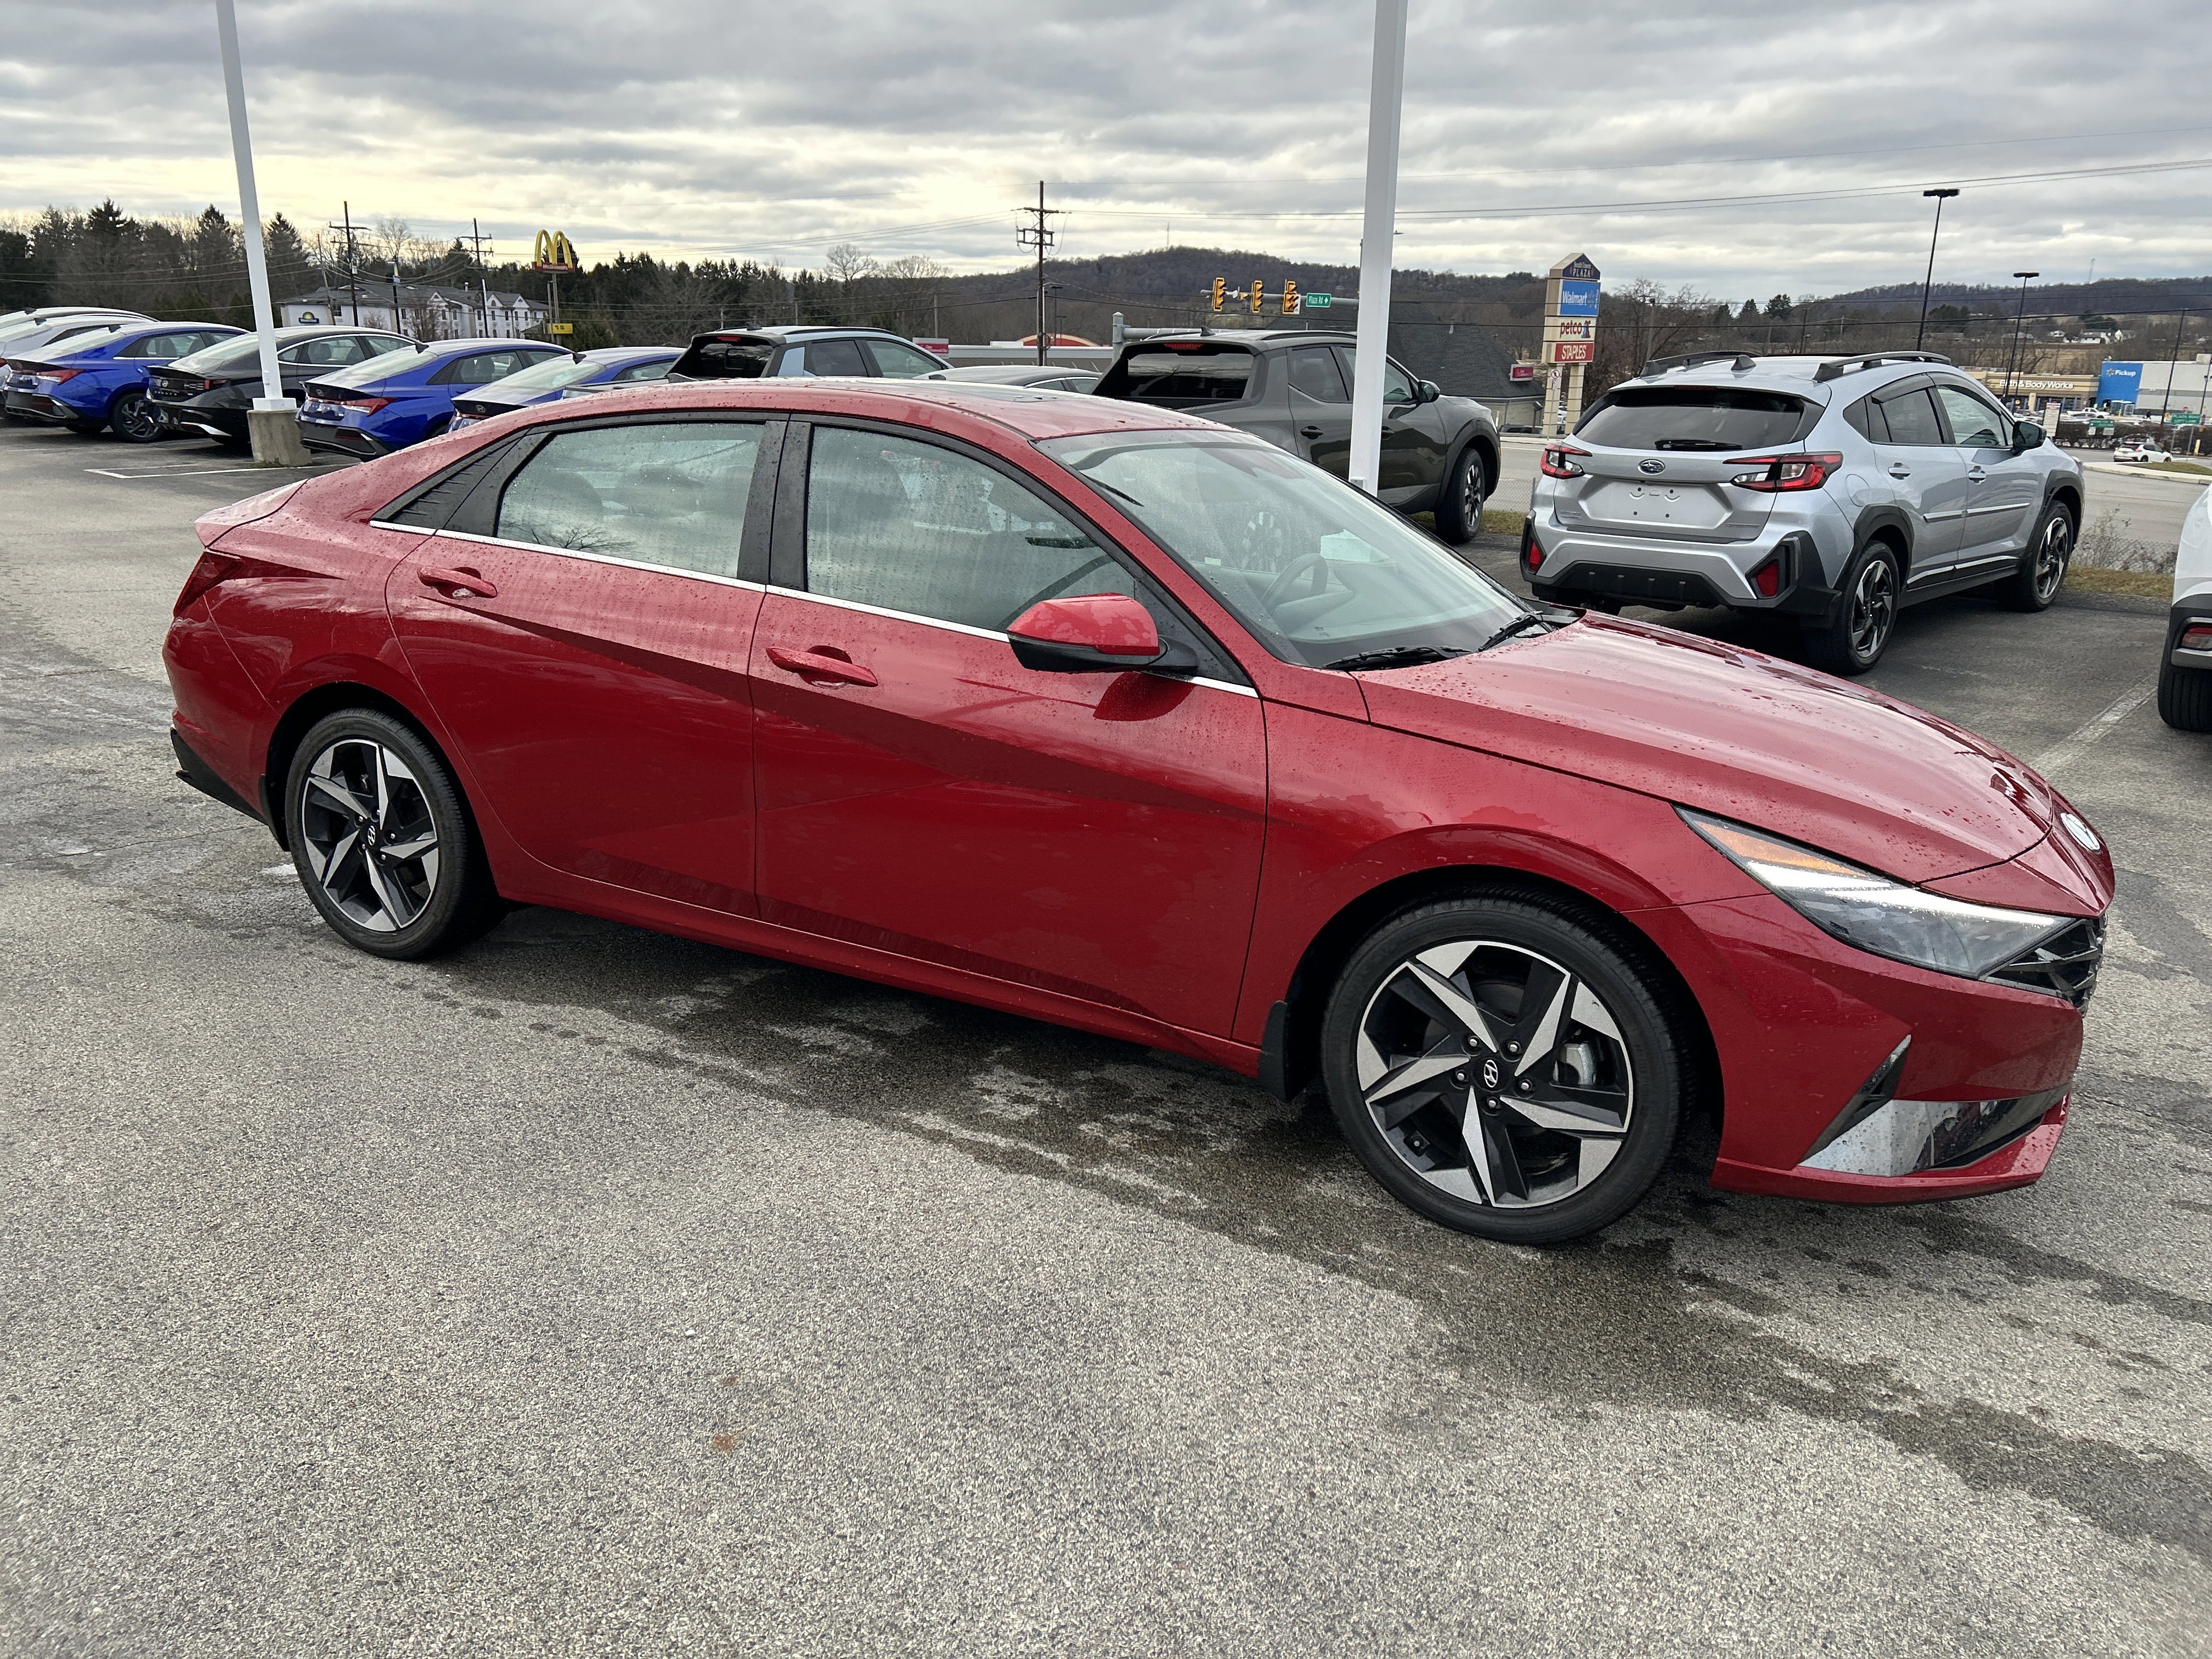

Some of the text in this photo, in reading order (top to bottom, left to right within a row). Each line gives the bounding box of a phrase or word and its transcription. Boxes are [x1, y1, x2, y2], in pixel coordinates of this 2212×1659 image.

[1572, 267, 1590, 278] PLAZA
[1562, 291, 1587, 306] Walmart
[1560, 320, 1582, 338] petco
[1562, 345, 1587, 359] STAPLES
[2115, 369, 2136, 377] Pickup
[2025, 380, 2046, 390] Body
